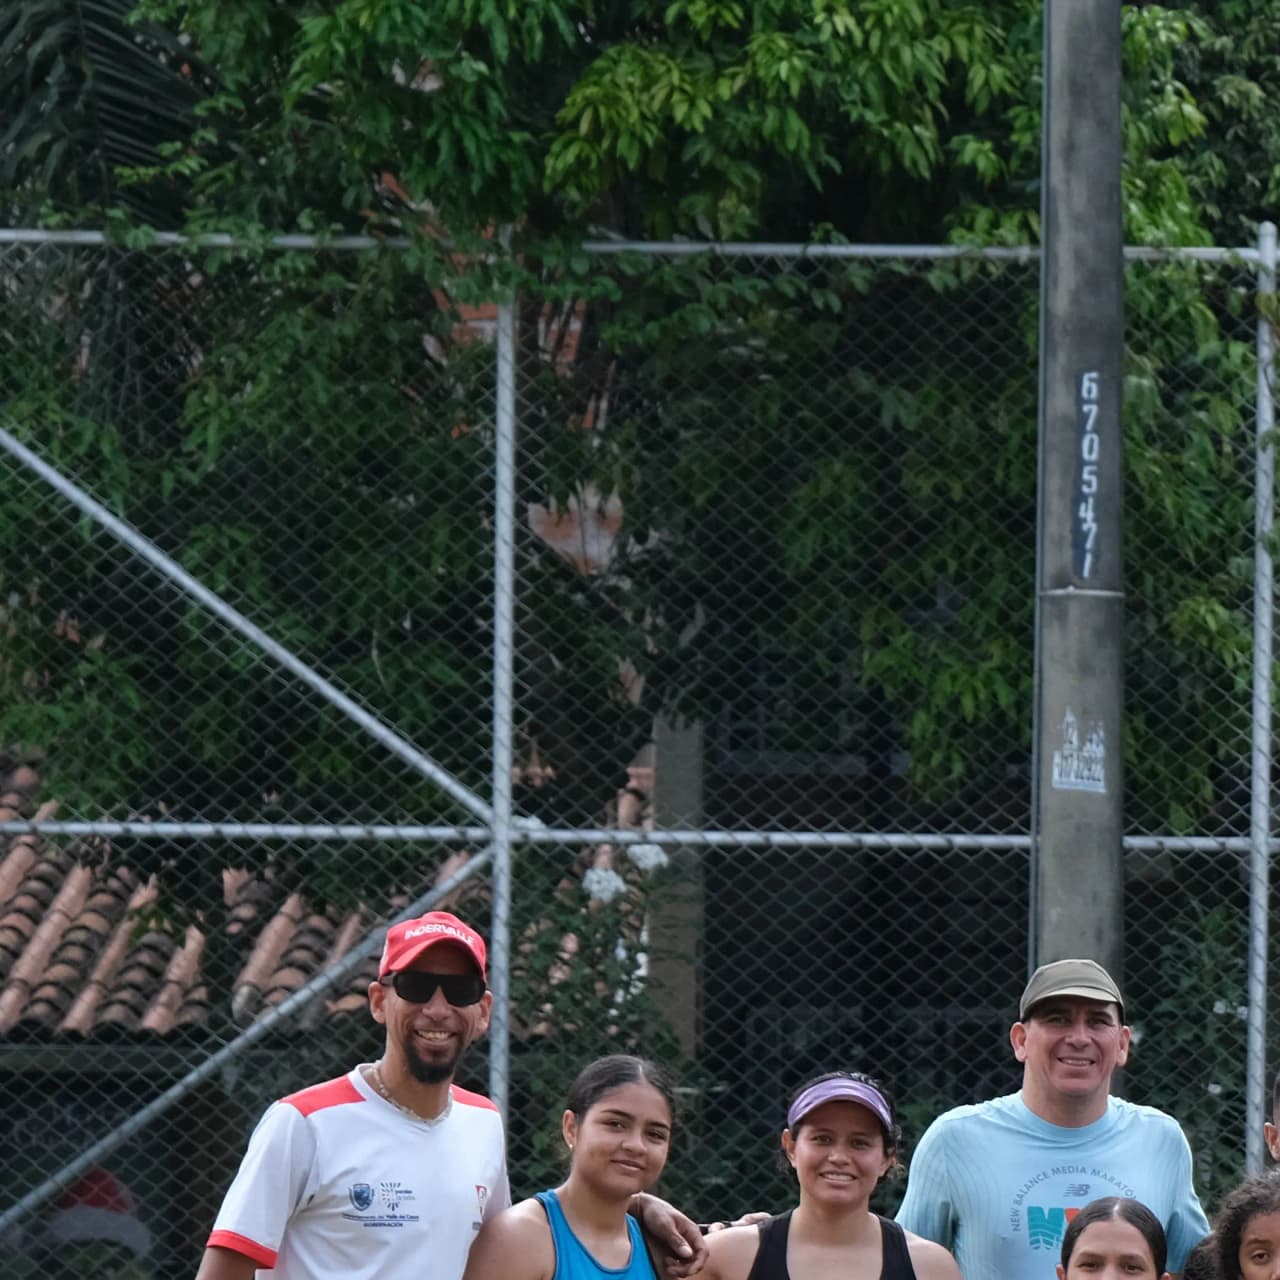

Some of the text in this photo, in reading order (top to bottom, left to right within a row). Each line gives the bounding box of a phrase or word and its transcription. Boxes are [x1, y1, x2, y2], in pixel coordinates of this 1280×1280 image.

[404, 924, 474, 945] INDERVALLE
[1014, 1171, 1050, 1206] BALANCE
[1052, 1165, 1087, 1176] MEDIA
